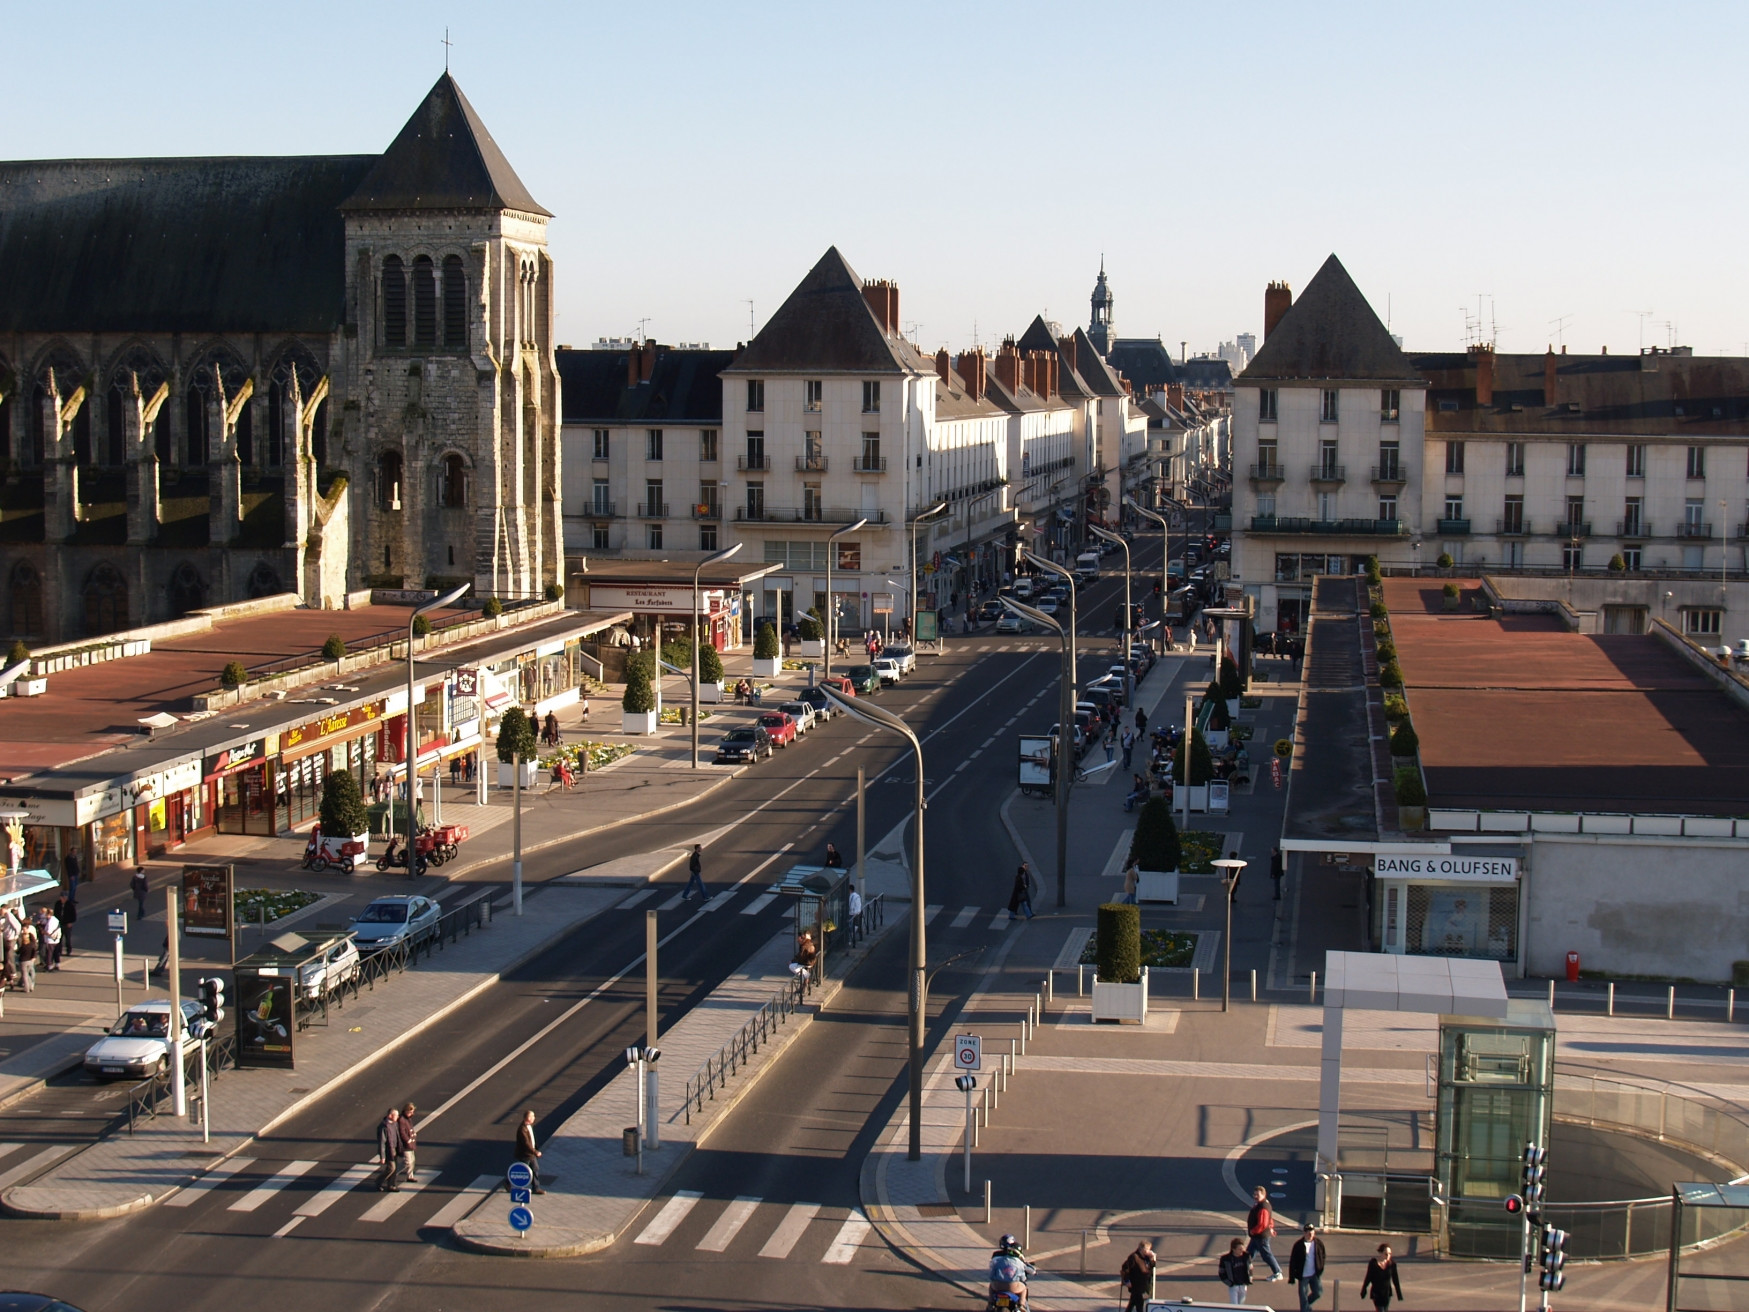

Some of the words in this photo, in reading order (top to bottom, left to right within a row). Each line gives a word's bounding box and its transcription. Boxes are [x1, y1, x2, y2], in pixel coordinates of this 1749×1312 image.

[1272, 759, 1280, 788] TABAC
[1377, 859, 1421, 873] BANG
[1426, 860, 1436, 873] &
[1440, 860, 1512, 876] OLUFSEN
